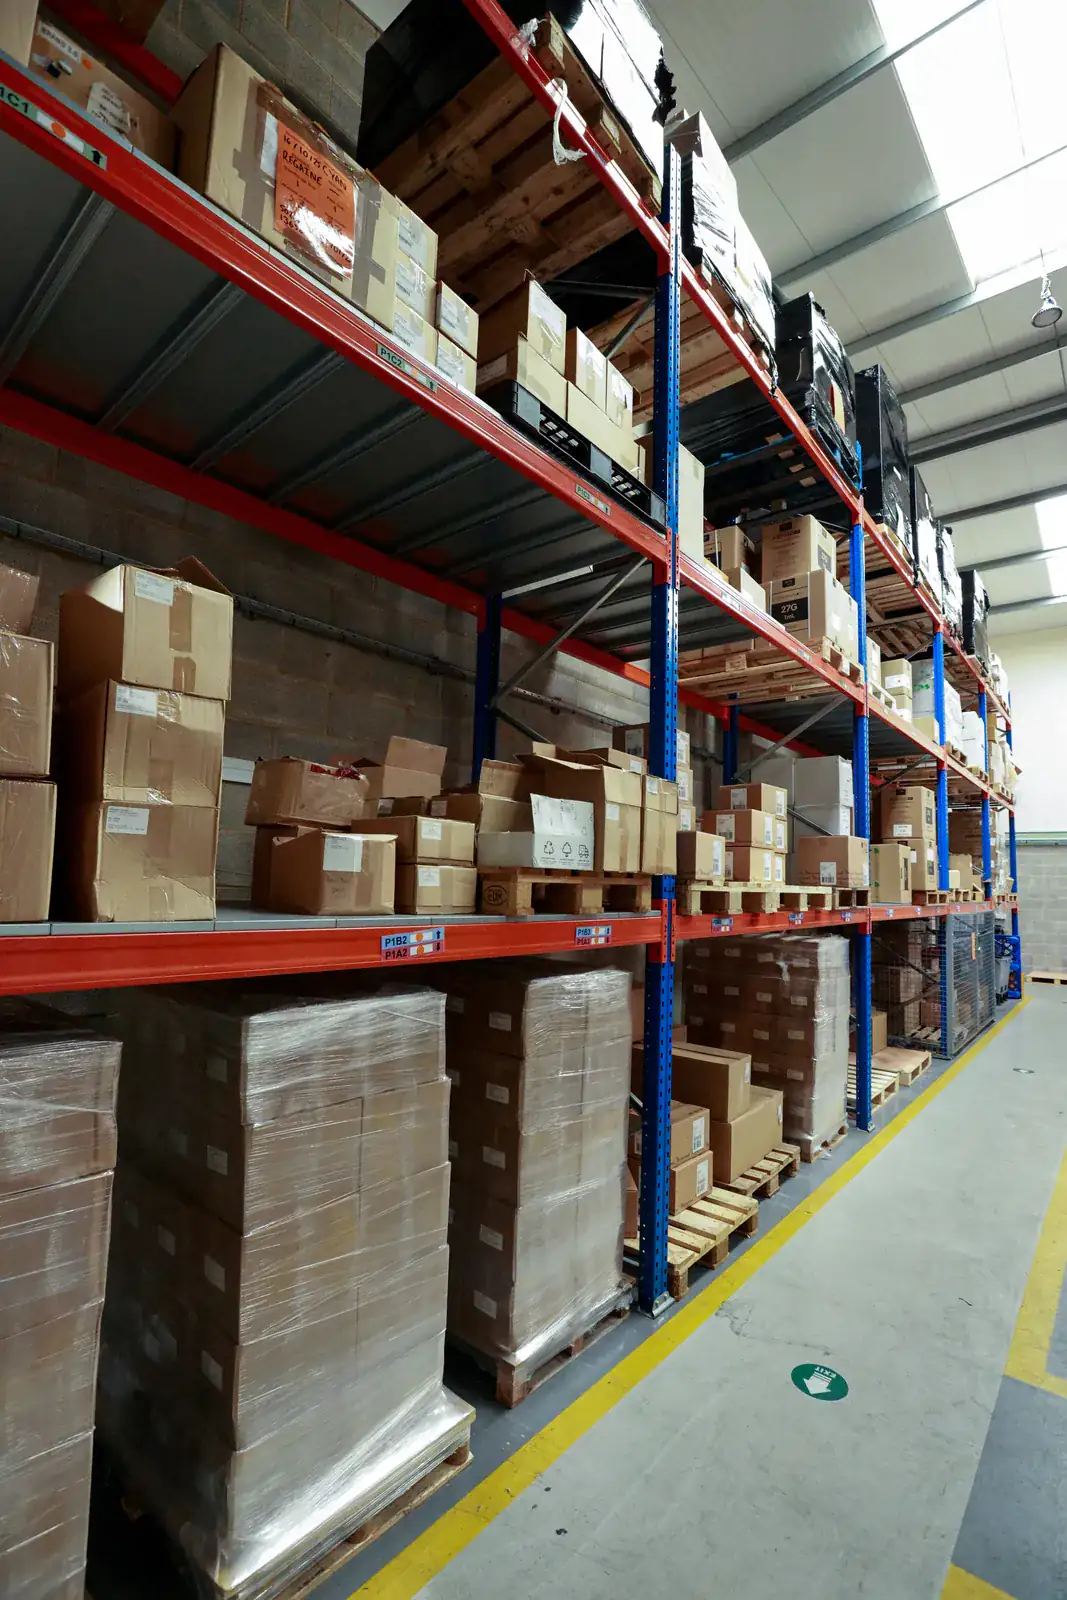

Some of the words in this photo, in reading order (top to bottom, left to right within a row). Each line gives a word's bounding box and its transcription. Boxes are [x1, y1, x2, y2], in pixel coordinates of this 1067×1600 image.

[283, 150, 322, 185] REGAINE
[380, 347, 402, 368] P1C2
[781, 603, 798, 613] 27G
[385, 935, 407, 947] P1B2
[385, 948, 407, 960] P1A2
[815, 1366, 837, 1379] EXIT
